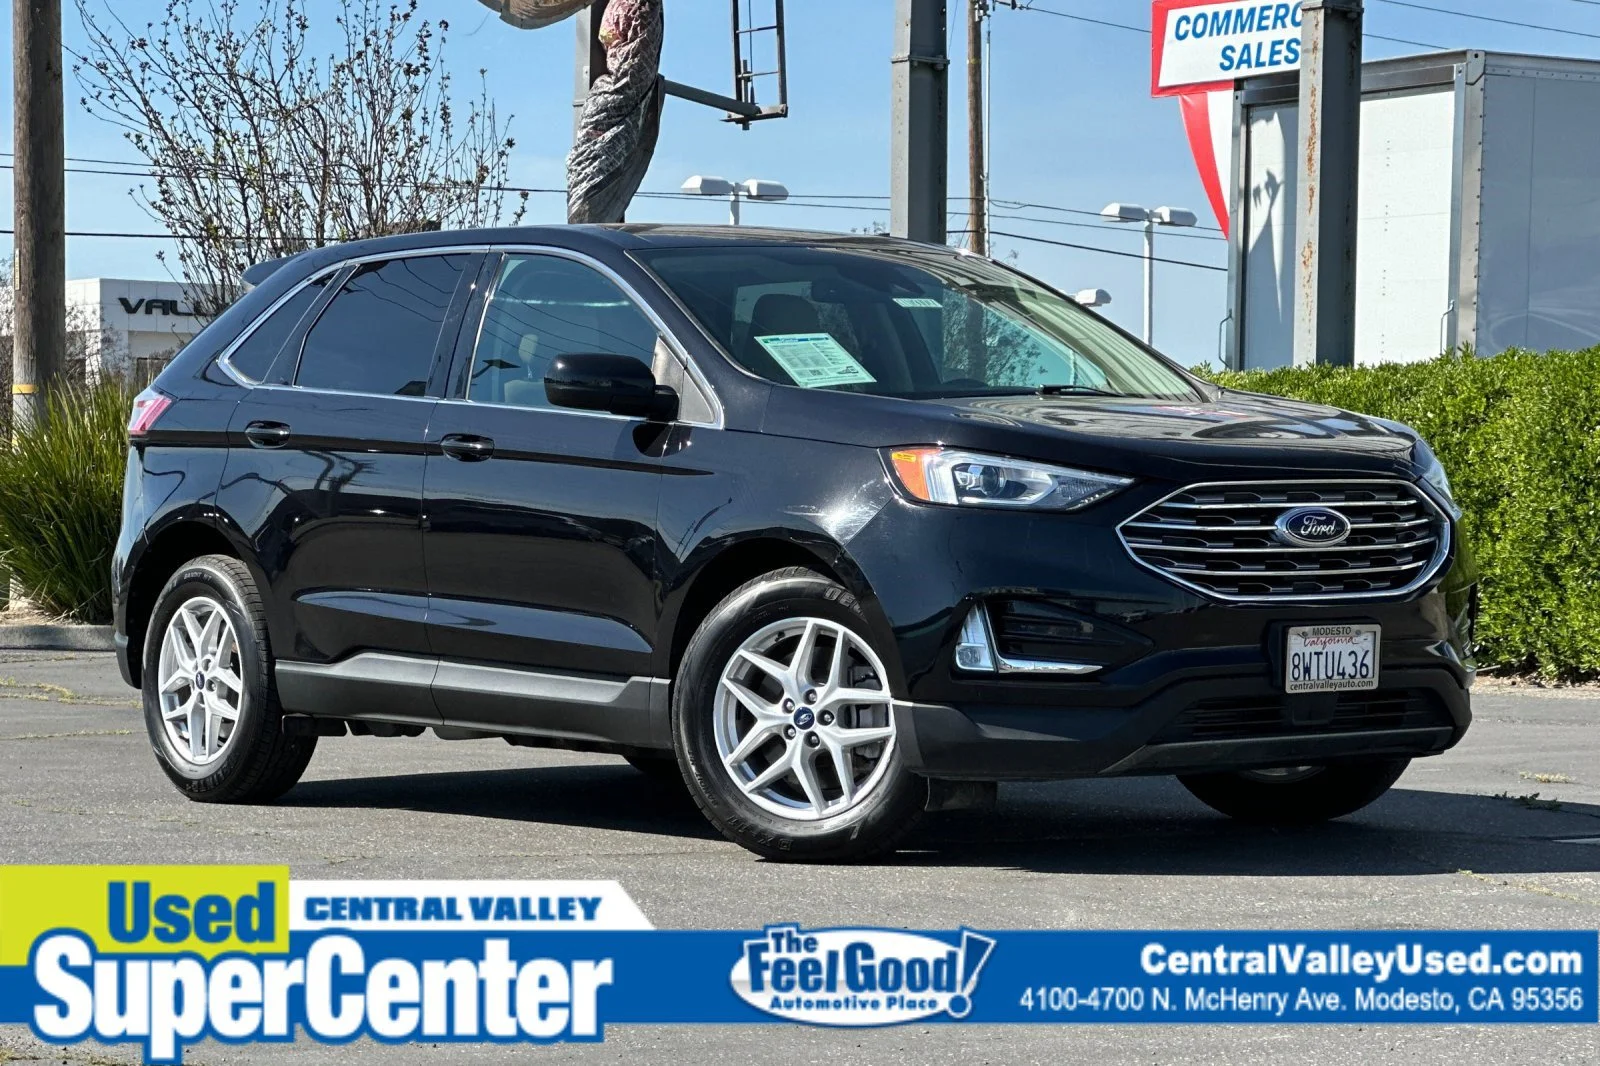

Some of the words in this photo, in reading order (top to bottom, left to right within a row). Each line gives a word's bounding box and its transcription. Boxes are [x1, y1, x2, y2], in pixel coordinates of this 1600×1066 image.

[1219, 37, 1300, 71] SALES
[1300, 515, 1337, 536] Ford
[1312, 627, 1352, 636] MODESTO
[1303, 635, 1359, 651] California
[1291, 650, 1370, 682] 8WTU436
[1290, 679, 1374, 692] centralvalleyauto.com
